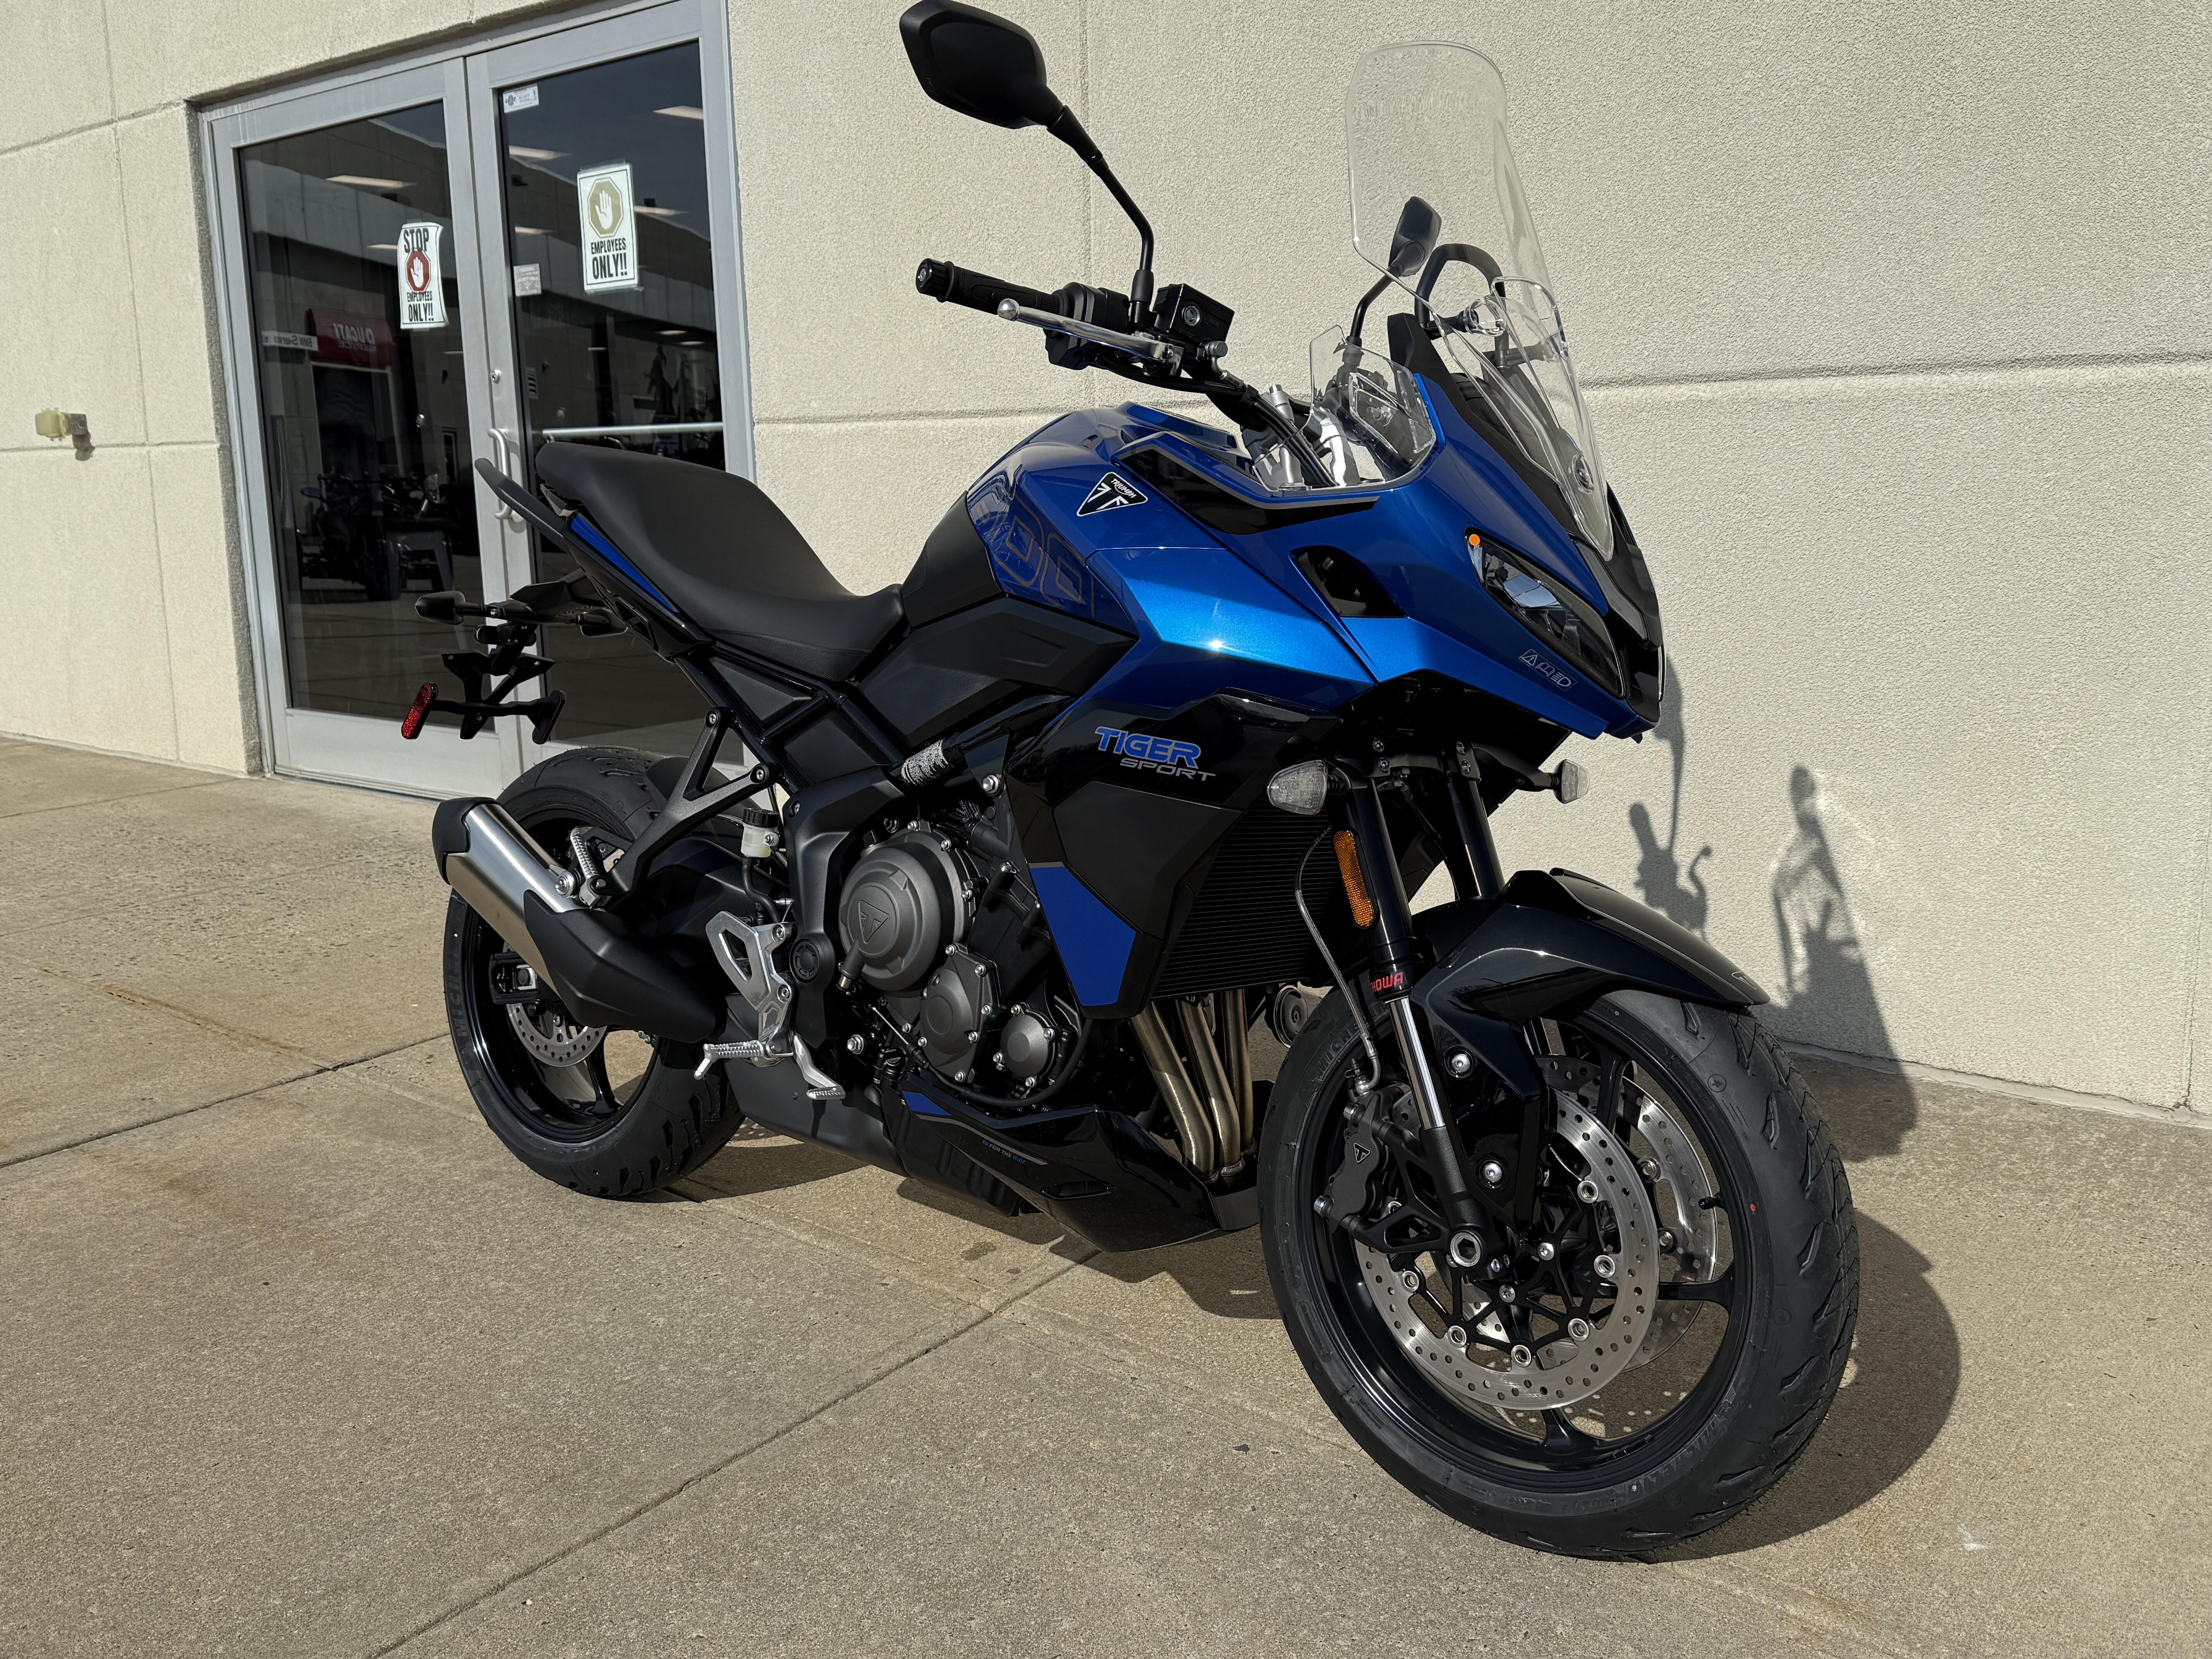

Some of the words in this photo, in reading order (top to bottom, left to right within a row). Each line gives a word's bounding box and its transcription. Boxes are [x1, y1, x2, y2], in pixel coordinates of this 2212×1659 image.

[404, 228, 429, 253] STOP
[591, 237, 627, 255] EMPLOYEES
[592, 252, 627, 280] ONLY!!
[407, 291, 433, 302] EMPLOYEES
[408, 303, 434, 322] ONLY!!
[1111, 478, 1137, 498] TRIUMPH
[1095, 726, 1201, 769] TIGER
[1120, 757, 1216, 781] SPORT
[1371, 972, 1404, 992] HOWA
[989, 1143, 1001, 1153] FOR
[1001, 1149, 1013, 1158] THE
[1012, 1154, 1028, 1165] RIDE
